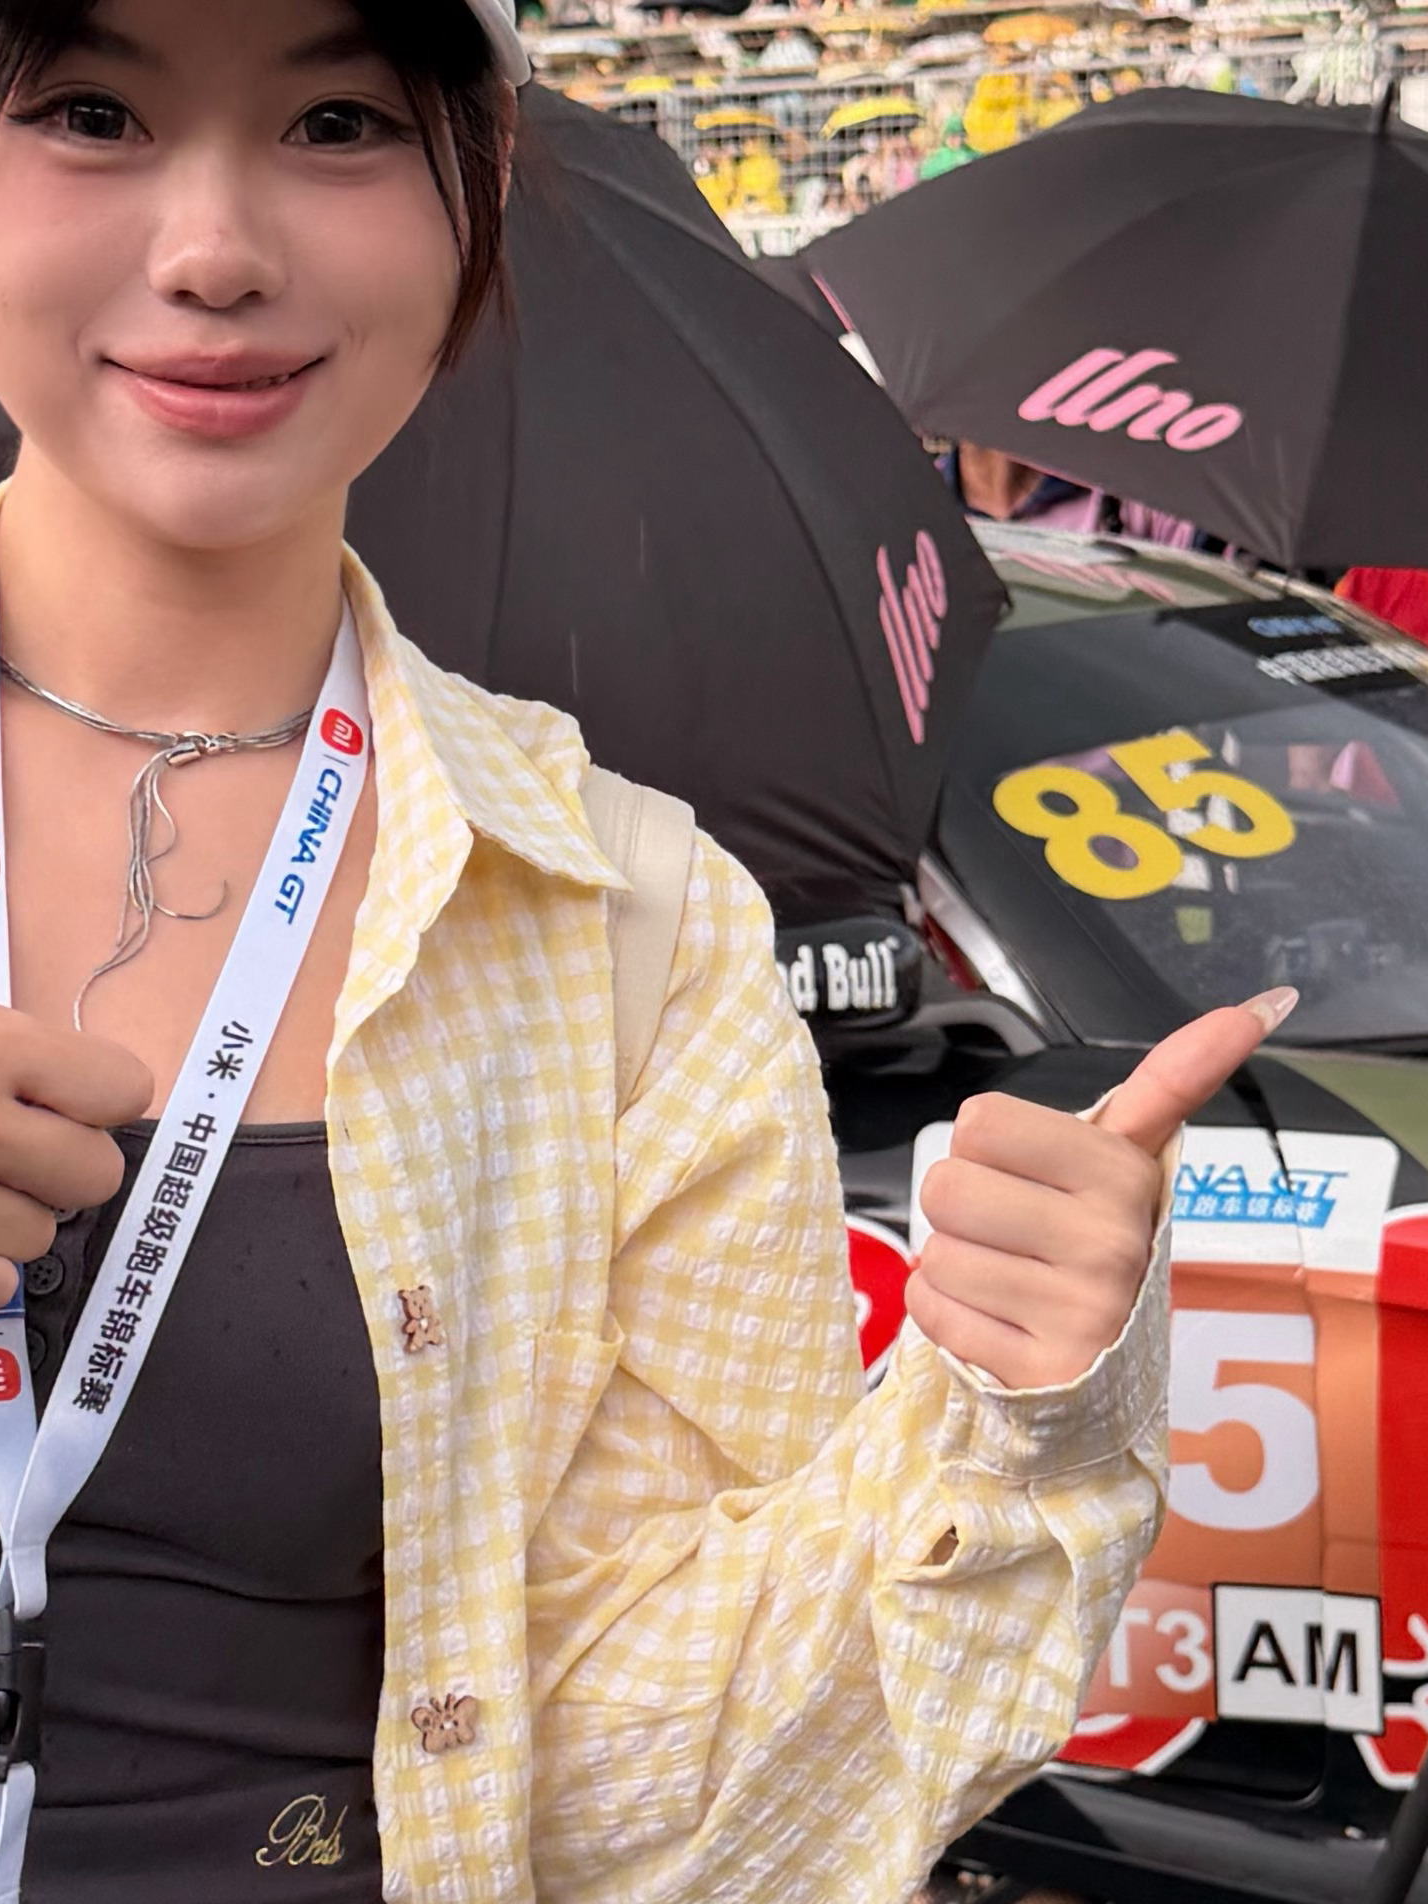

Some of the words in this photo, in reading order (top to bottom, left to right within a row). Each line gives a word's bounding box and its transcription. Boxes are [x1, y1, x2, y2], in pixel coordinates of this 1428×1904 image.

[291, 768, 343, 864] CHINA
[993, 727, 1297, 901] 85
[274, 873, 306, 926] GT
[822, 938, 897, 1011] Bull
[1232, 1620, 1360, 1696] AM
